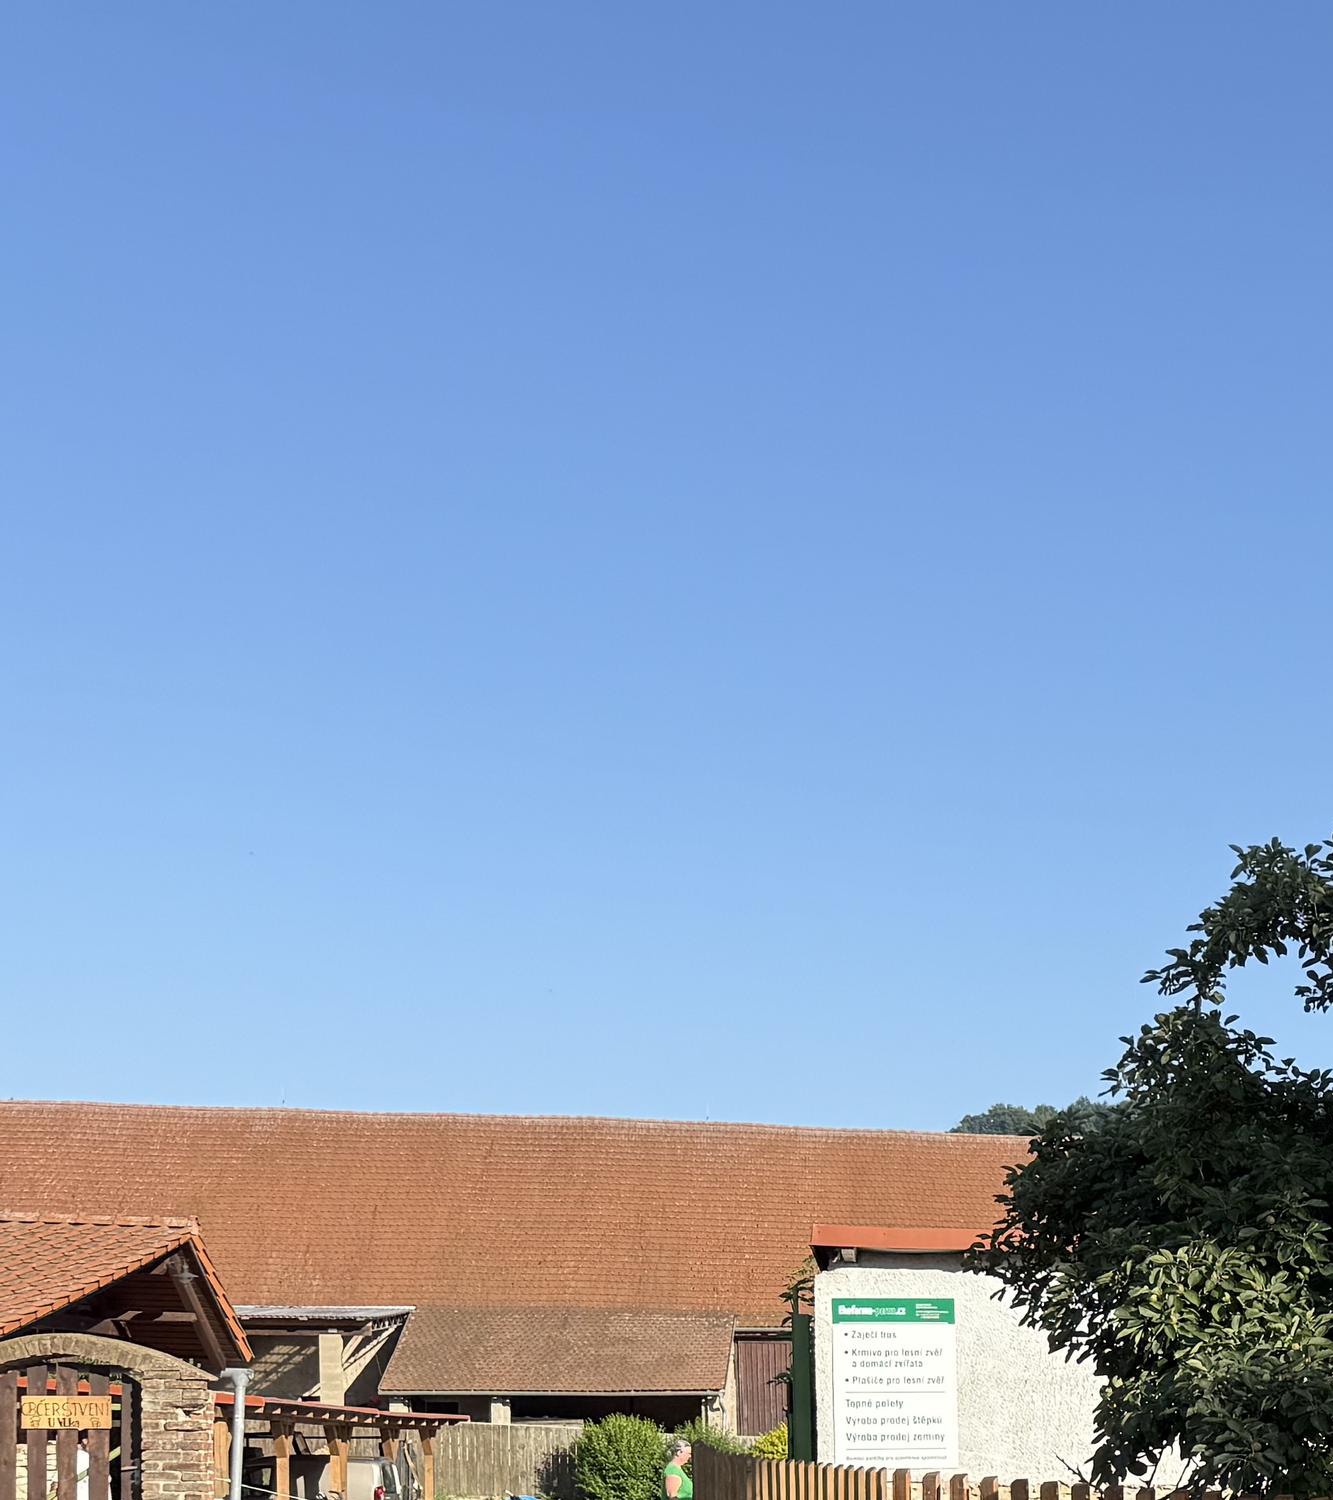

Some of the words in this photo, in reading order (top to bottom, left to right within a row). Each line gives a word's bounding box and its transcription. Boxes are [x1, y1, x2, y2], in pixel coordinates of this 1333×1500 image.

[851, 1348, 882, 1357] Krmivo
[884, 1350, 899, 1358] pro
[886, 1378, 901, 1387] pro
[845, 1399, 872, 1409] Topné
[880, 1416, 910, 1426] prodej
[880, 1432, 910, 1443] prodej
